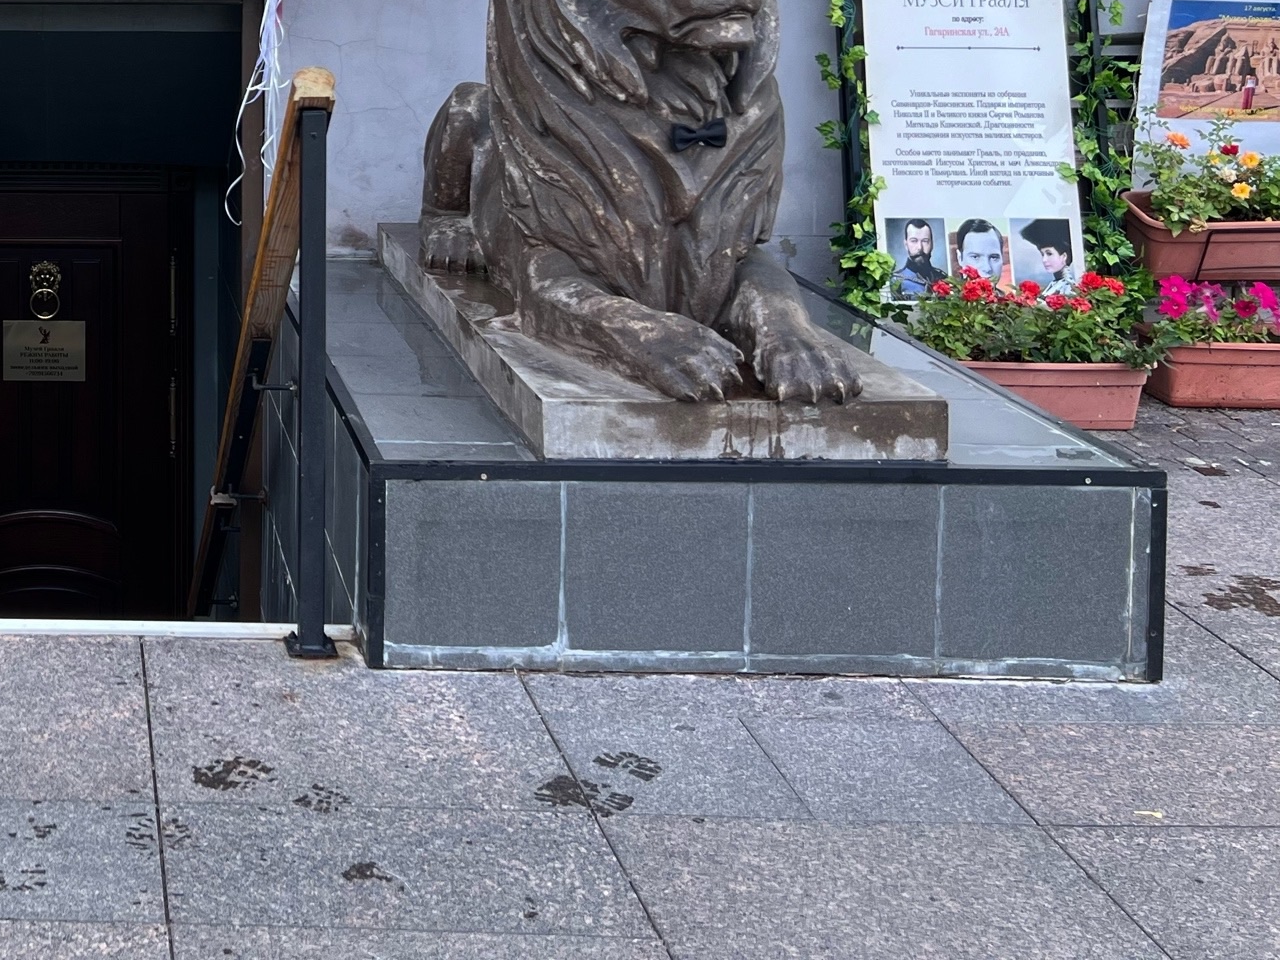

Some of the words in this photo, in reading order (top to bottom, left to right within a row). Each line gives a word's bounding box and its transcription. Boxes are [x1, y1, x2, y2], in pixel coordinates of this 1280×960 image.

[961, 16, 984, 24] адресу:
[924, 26, 976, 38] Гагаринская
[909, 89, 950, 97] Уникальные
[976, 100, 1006, 109] Подарки
[893, 110, 923, 118] Николая
[936, 110, 967, 118] Великого
[988, 110, 1012, 120] Сергея
[1013, 111, 1045, 119] Романова
[984, 121, 1035, 130] Драгоценности
[903, 132, 949, 140] произведения
[895, 148, 921, 156] Особое
[892, 168, 923, 176] Невского
[969, 168, 988, 176] Иной
